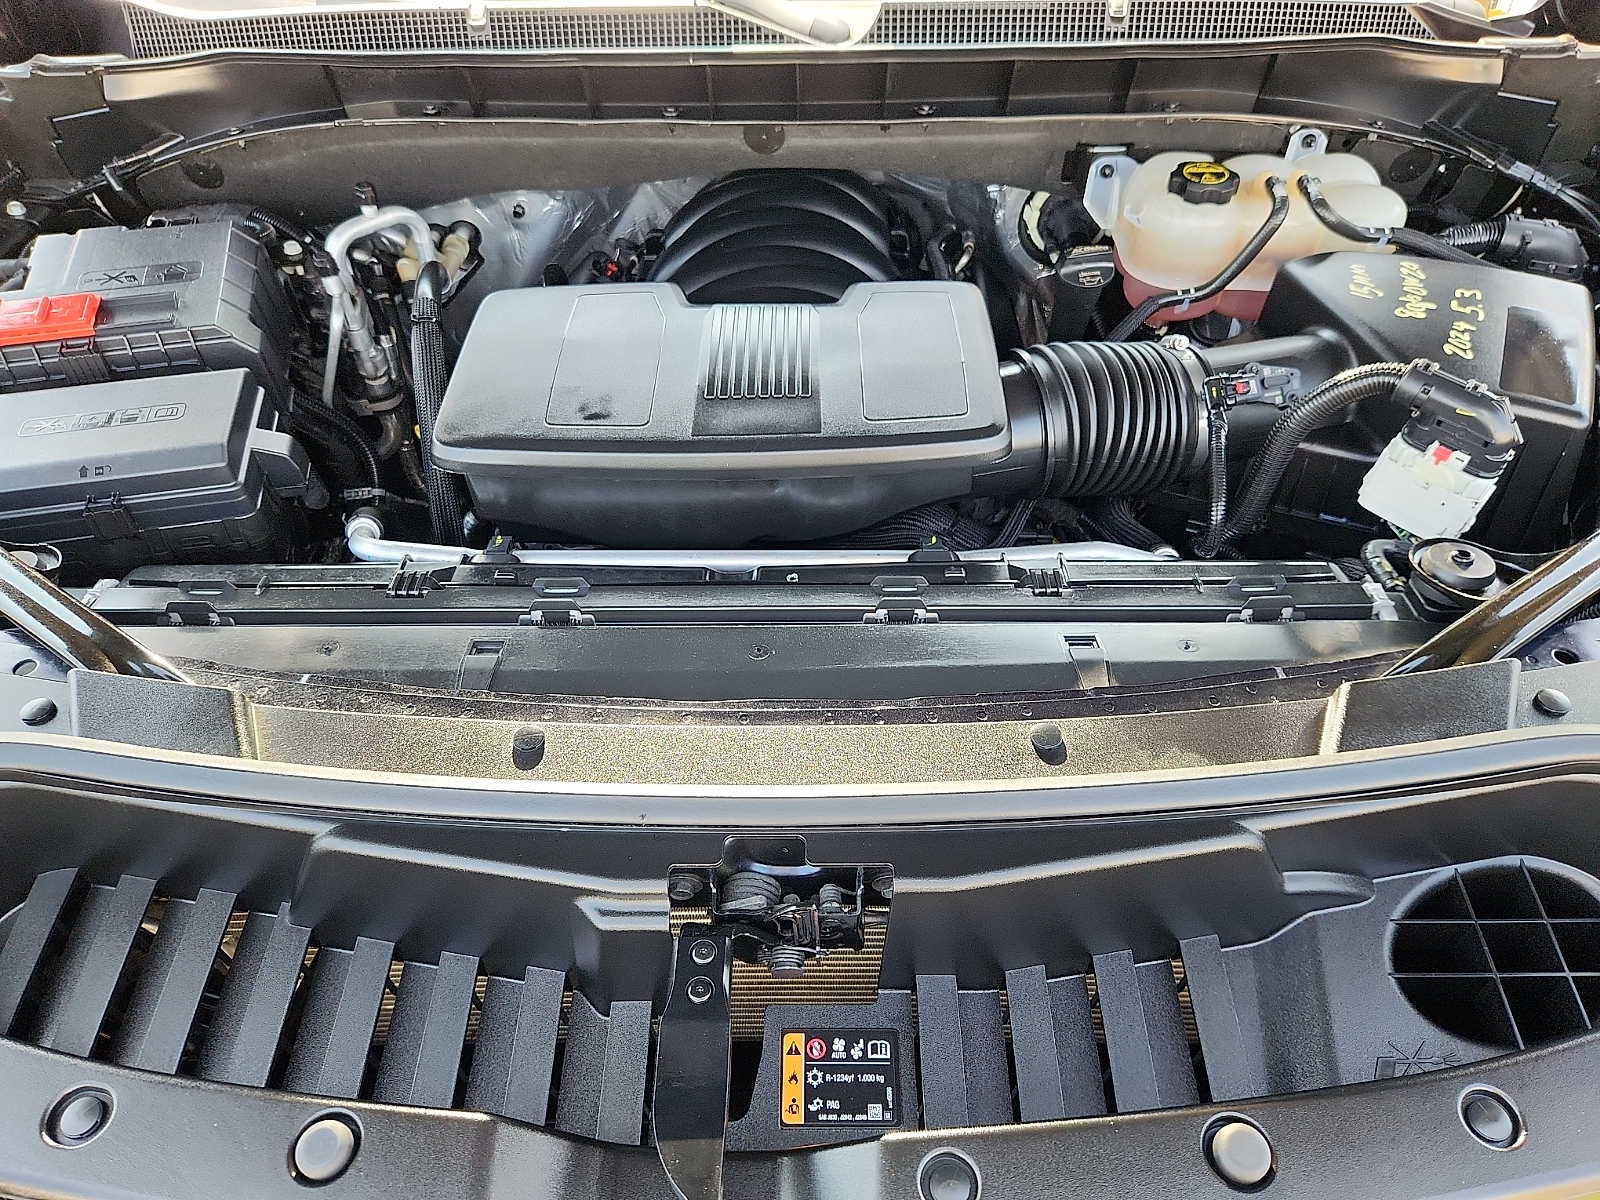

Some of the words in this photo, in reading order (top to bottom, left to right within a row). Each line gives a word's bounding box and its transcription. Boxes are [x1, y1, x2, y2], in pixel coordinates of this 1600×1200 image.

[1450, 288, 1485, 321] 5.3
[1442, 320, 1477, 360] 2024
[831, 1051, 847, 1059] AUTO
[825, 1073, 855, 1083] R-1234yf
[857, 1073, 875, 1082] 1.000
[875, 1073, 885, 1084] kg
[826, 1099, 840, 1110] PAG
